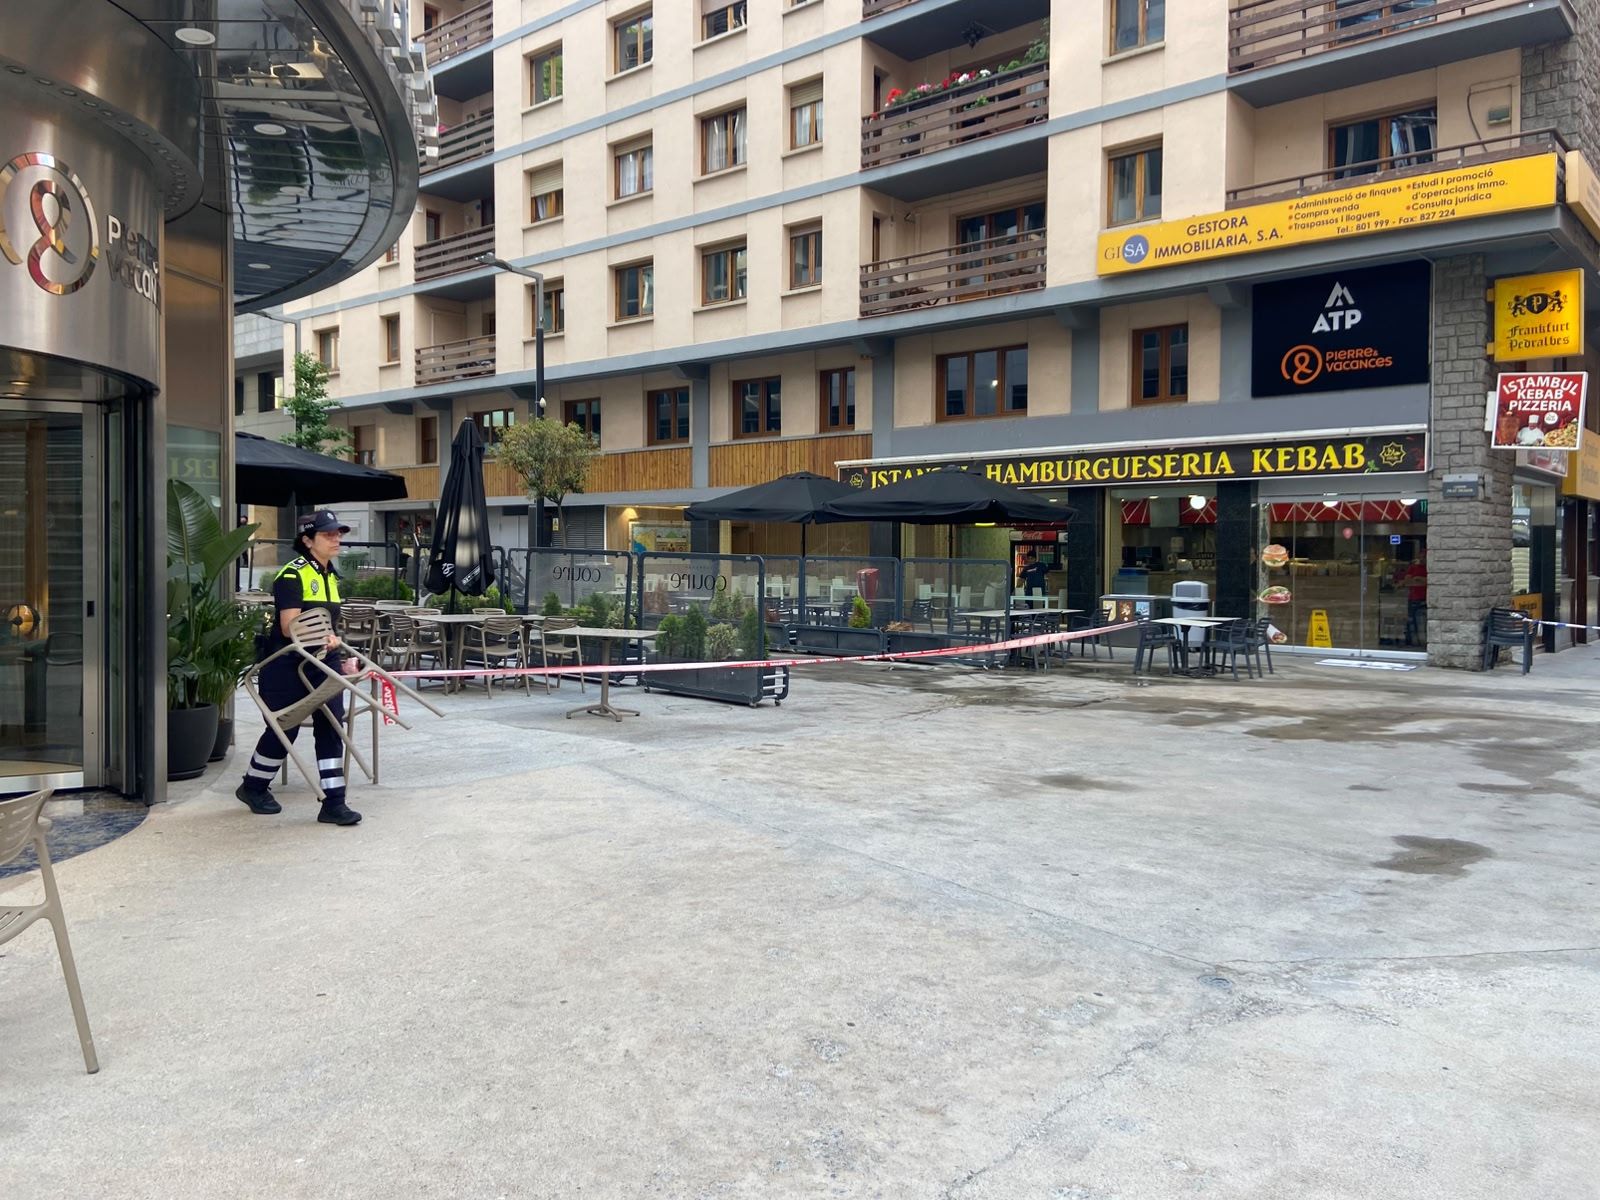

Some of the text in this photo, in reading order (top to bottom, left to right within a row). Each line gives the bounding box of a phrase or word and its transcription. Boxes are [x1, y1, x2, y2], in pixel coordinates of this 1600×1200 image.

[1412, 178, 1439, 190] Estudi
[1446, 168, 1494, 185] promoció
[1294, 186, 1402, 211] Administració de finques
[1411, 184, 1475, 200] d'operacions
[1294, 203, 1360, 221] Compra venda
[1411, 198, 1453, 211] Consulta
[1186, 215, 1248, 237] GESTORA
[1294, 216, 1339, 230] Traspassos
[1345, 210, 1381, 223] lloguers
[1355, 222, 1371, 231] 801
[1374, 219, 1390, 229] 999
[1420, 211, 1436, 221] 827
[1439, 208, 1456, 218] 224
[1154, 227, 1284, 260] IMMOBILIARIA, S.A.
[1312, 308, 1362, 334] ATP
[1506, 321, 1569, 340] Frankfurt
[1509, 336, 1570, 352] Pedralbes
[1502, 375, 1579, 396] ISTAMBUL
[1517, 388, 1564, 400] KEBAB
[1508, 400, 1572, 412] PIZZERIA
[985, 450, 1235, 486] HAMBURGUESERIA
[1251, 442, 1366, 473] KEBAB
